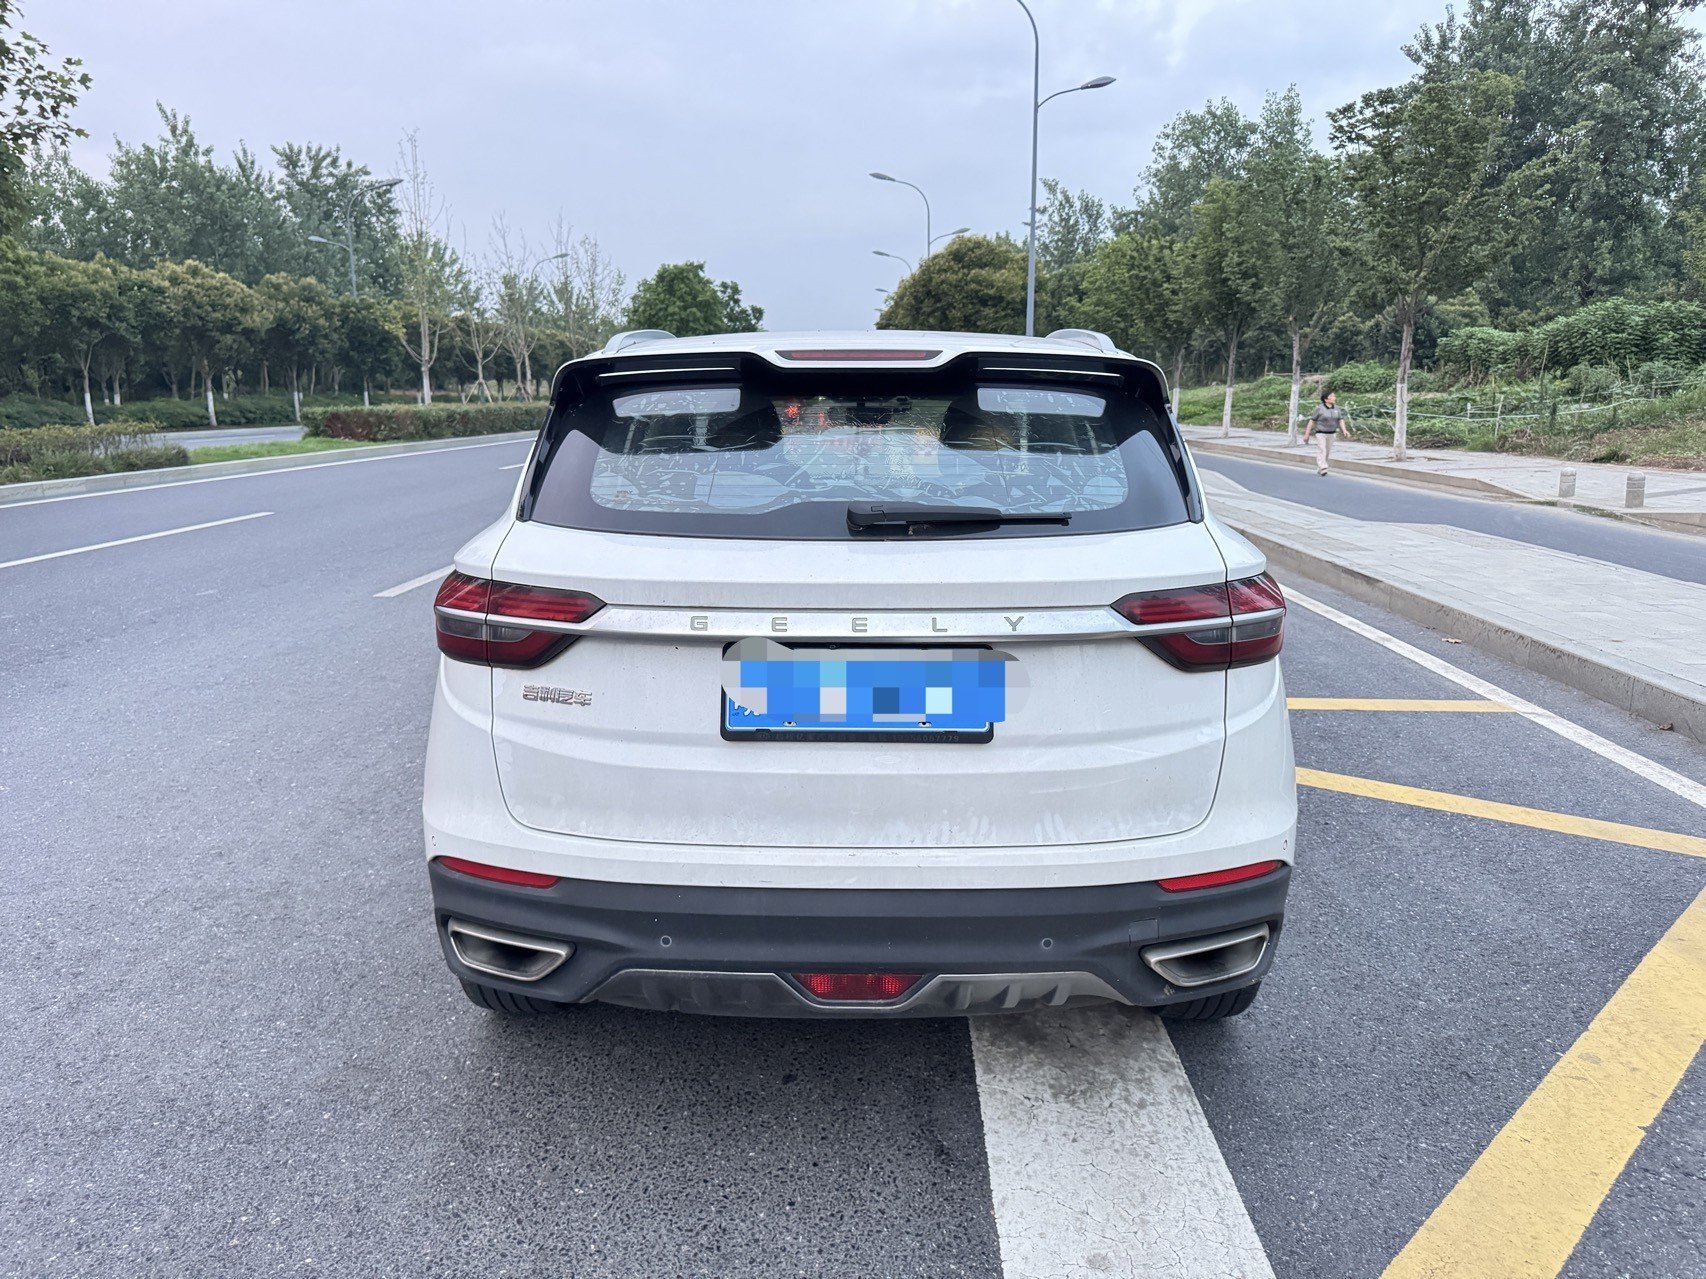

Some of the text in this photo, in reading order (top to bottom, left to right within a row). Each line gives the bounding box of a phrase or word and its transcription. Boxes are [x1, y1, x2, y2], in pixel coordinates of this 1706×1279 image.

[690, 615, 1024, 632] GEELY
[523, 685, 592, 706] 吉利汽车
